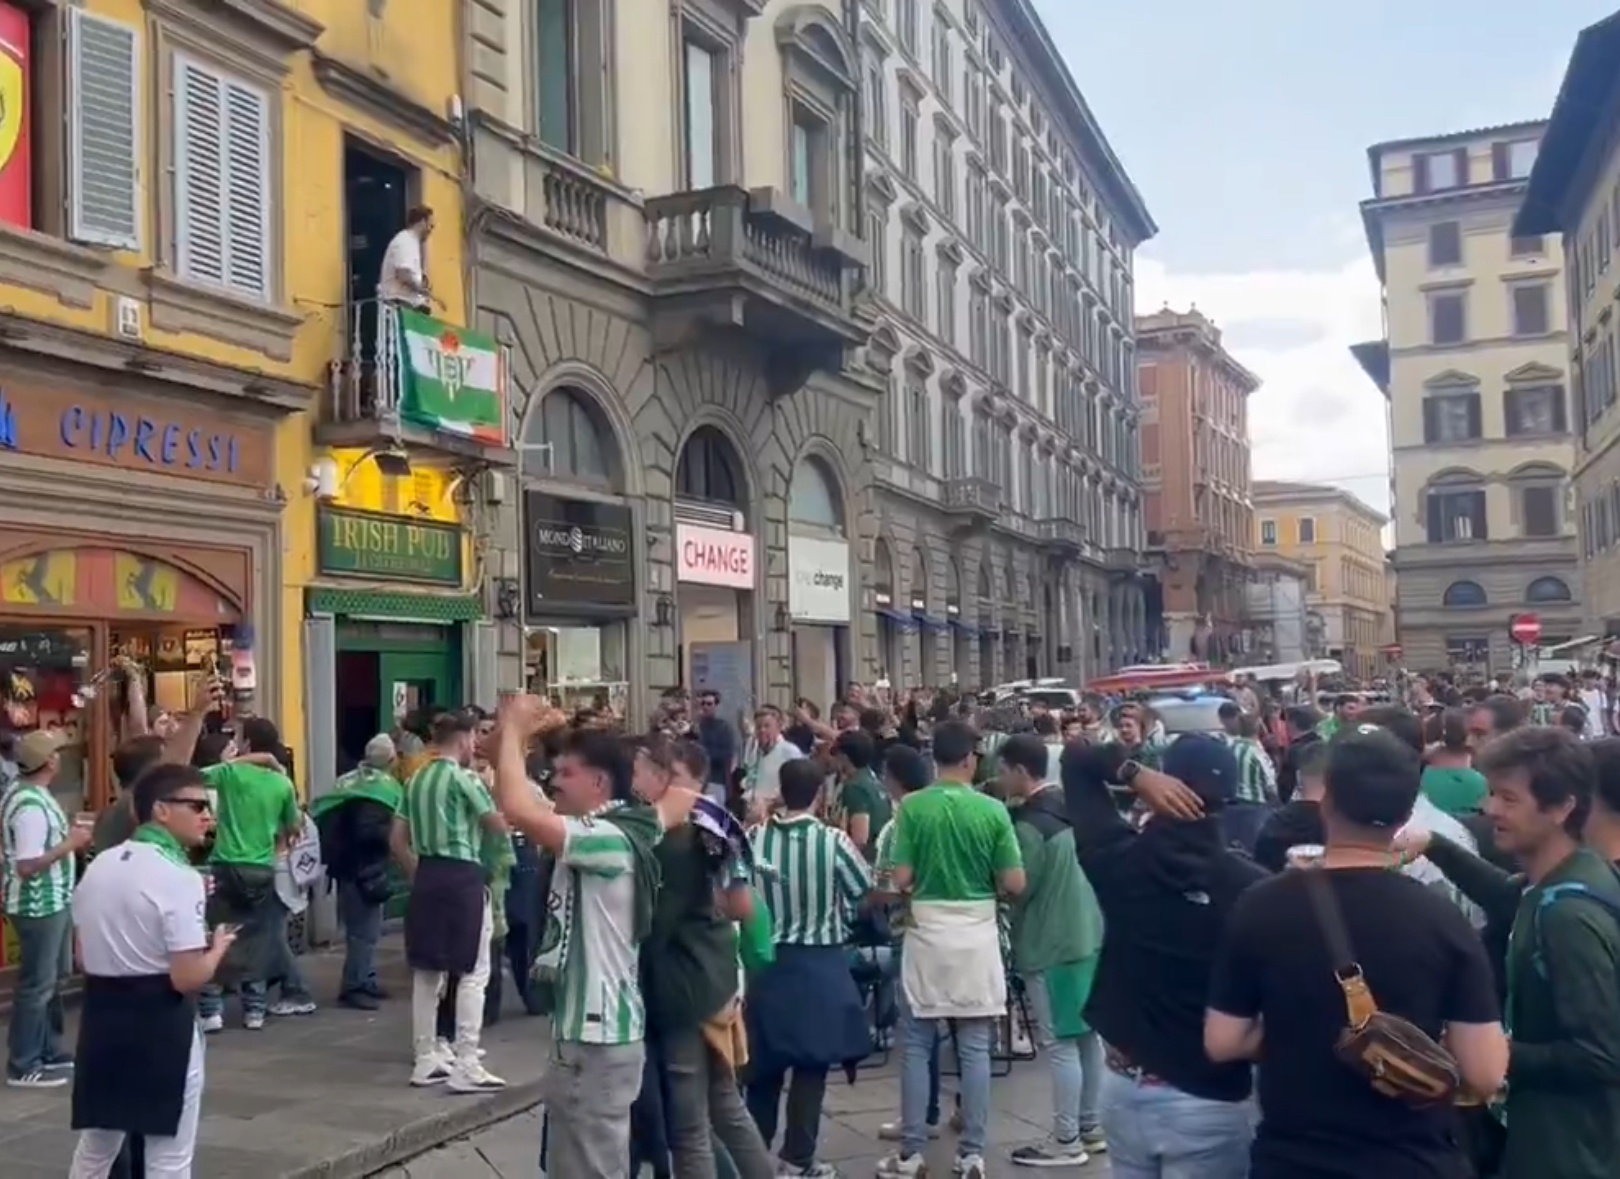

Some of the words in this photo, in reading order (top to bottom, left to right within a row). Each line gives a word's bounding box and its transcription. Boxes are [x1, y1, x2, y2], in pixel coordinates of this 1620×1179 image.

[60, 406, 240, 473] CIPRESSI
[331, 514, 398, 553] IRISH
[407, 525, 451, 560] PUB
[684, 540, 748, 574] CHANGE
[813, 570, 844, 591] change
